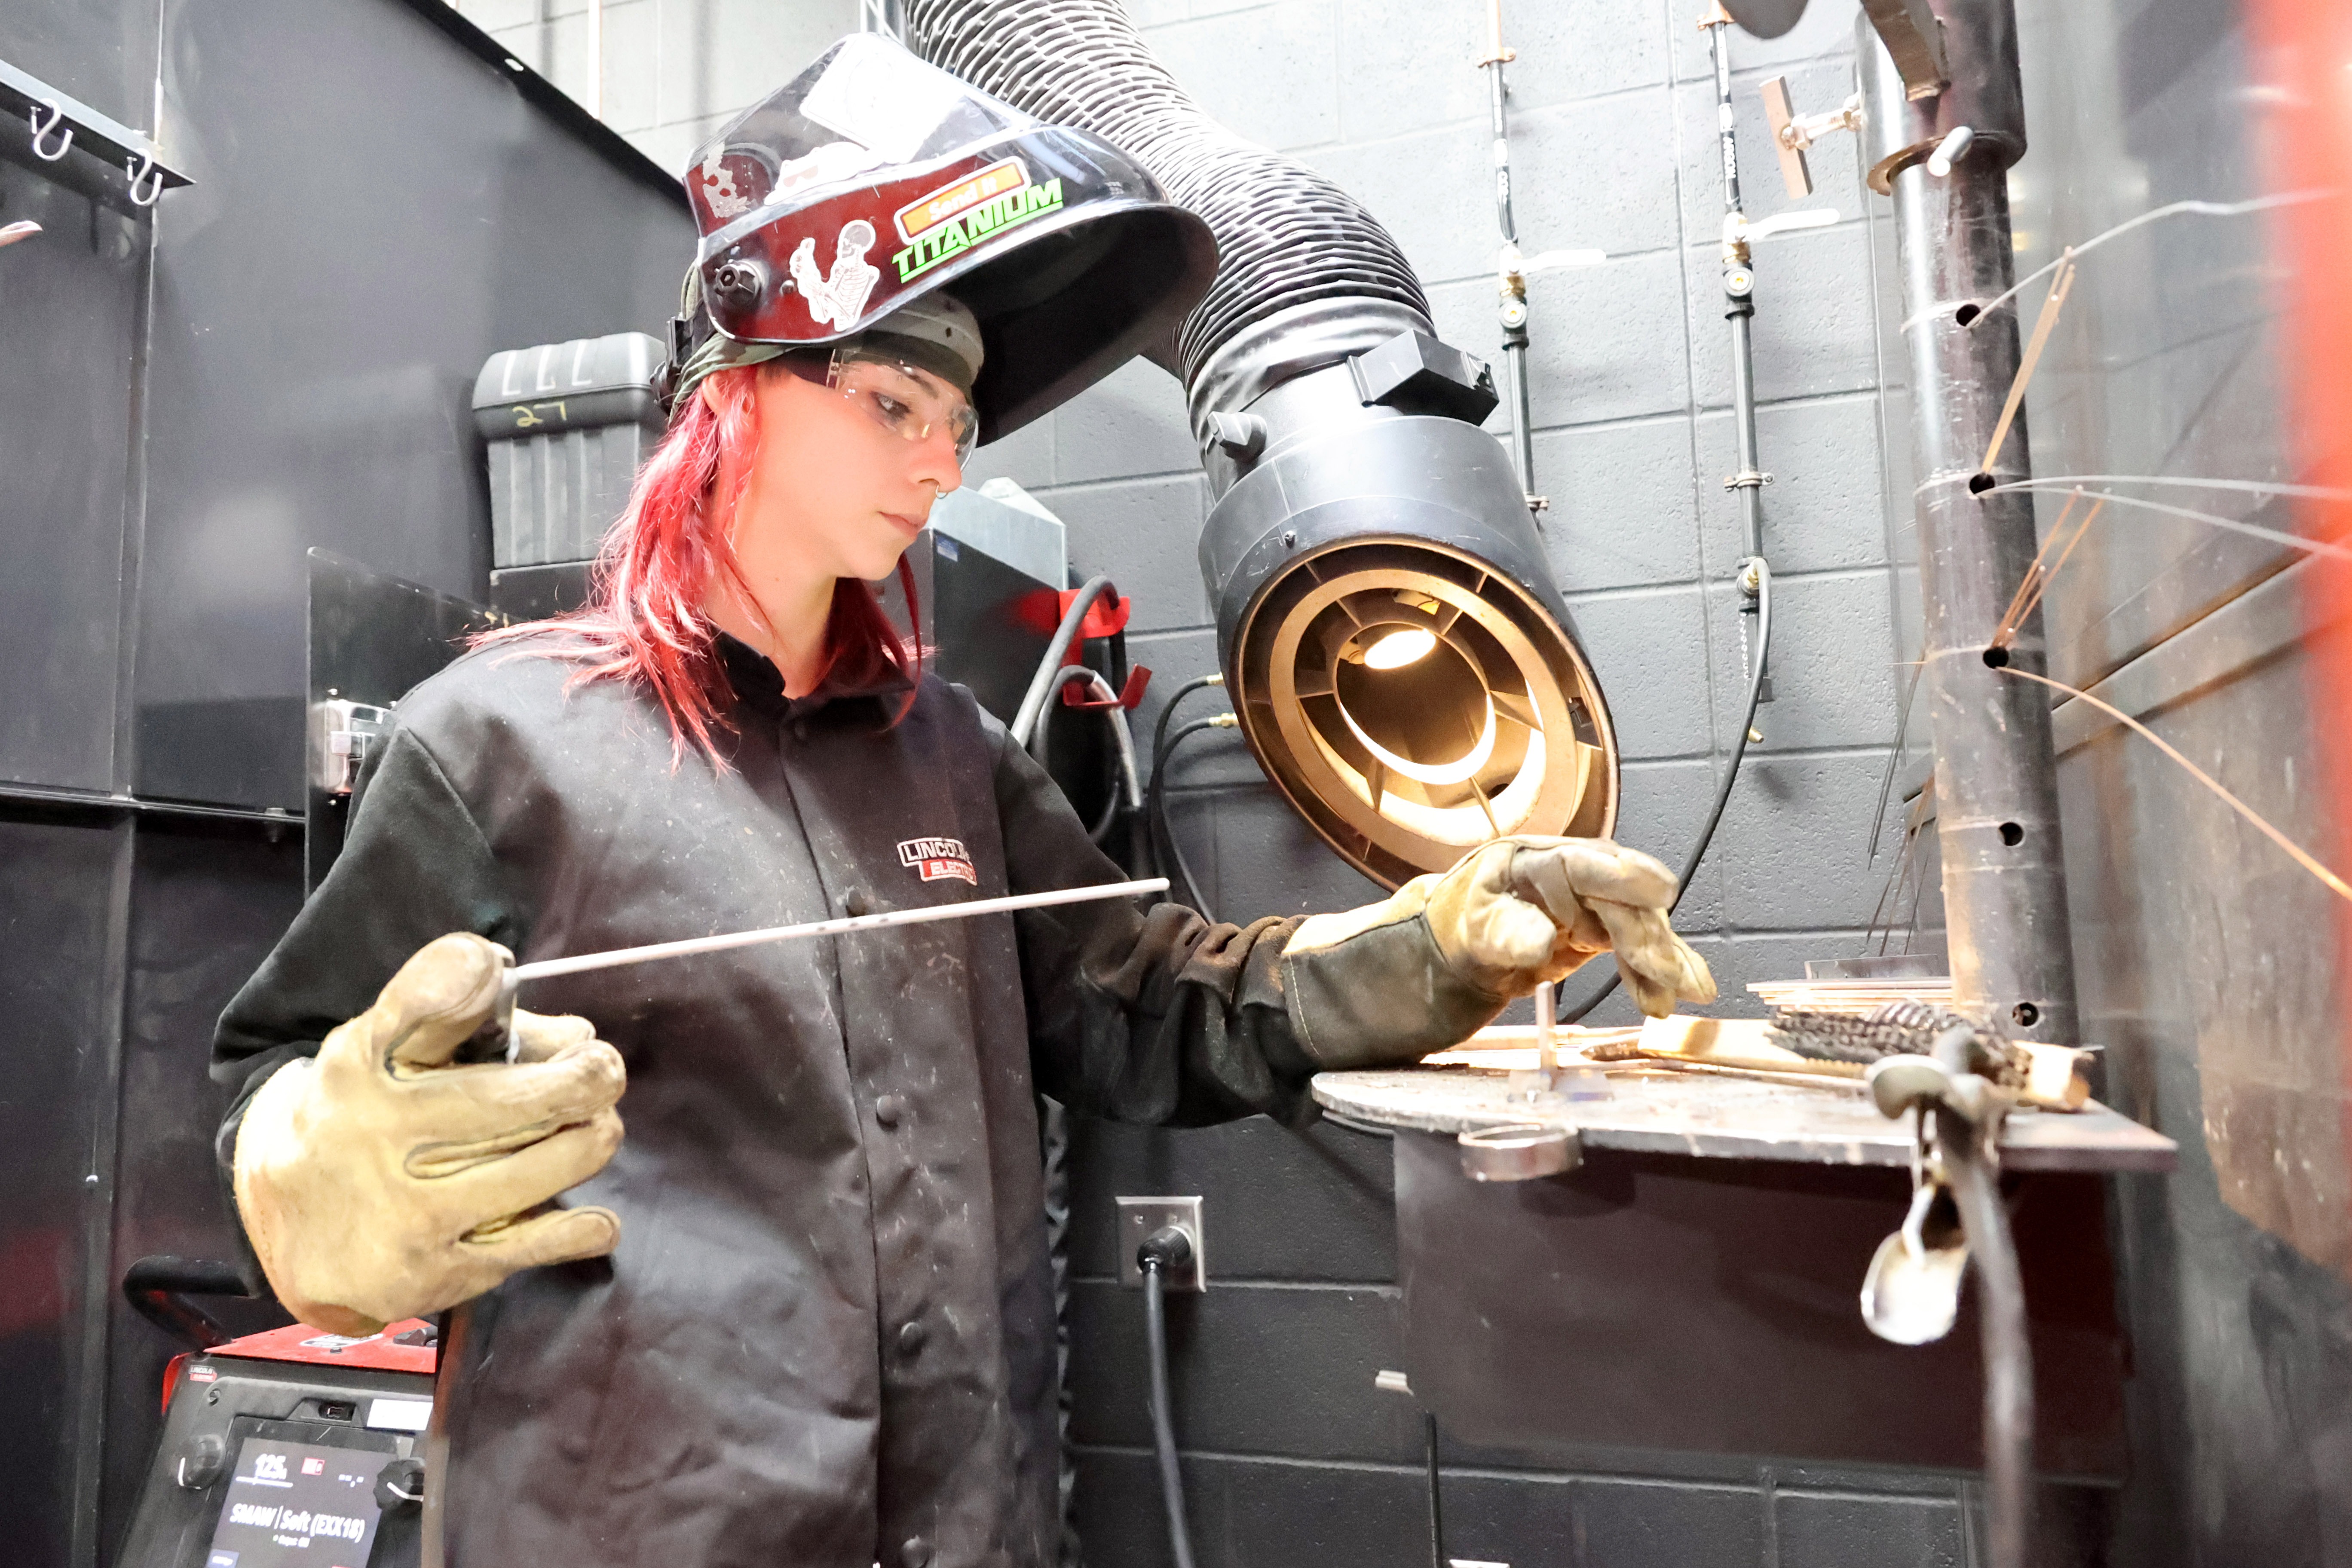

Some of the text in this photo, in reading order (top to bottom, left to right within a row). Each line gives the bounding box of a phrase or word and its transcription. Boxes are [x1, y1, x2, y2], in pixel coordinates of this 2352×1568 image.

[1723, 137, 1736, 179] ARGON
[928, 176, 998, 221] Send It
[892, 178, 1063, 277] TITANIUM
[230, 1503, 278, 1527] SMAW
[280, 1510, 311, 1532] Soft
[309, 1513, 365, 1543] (EXX18)
